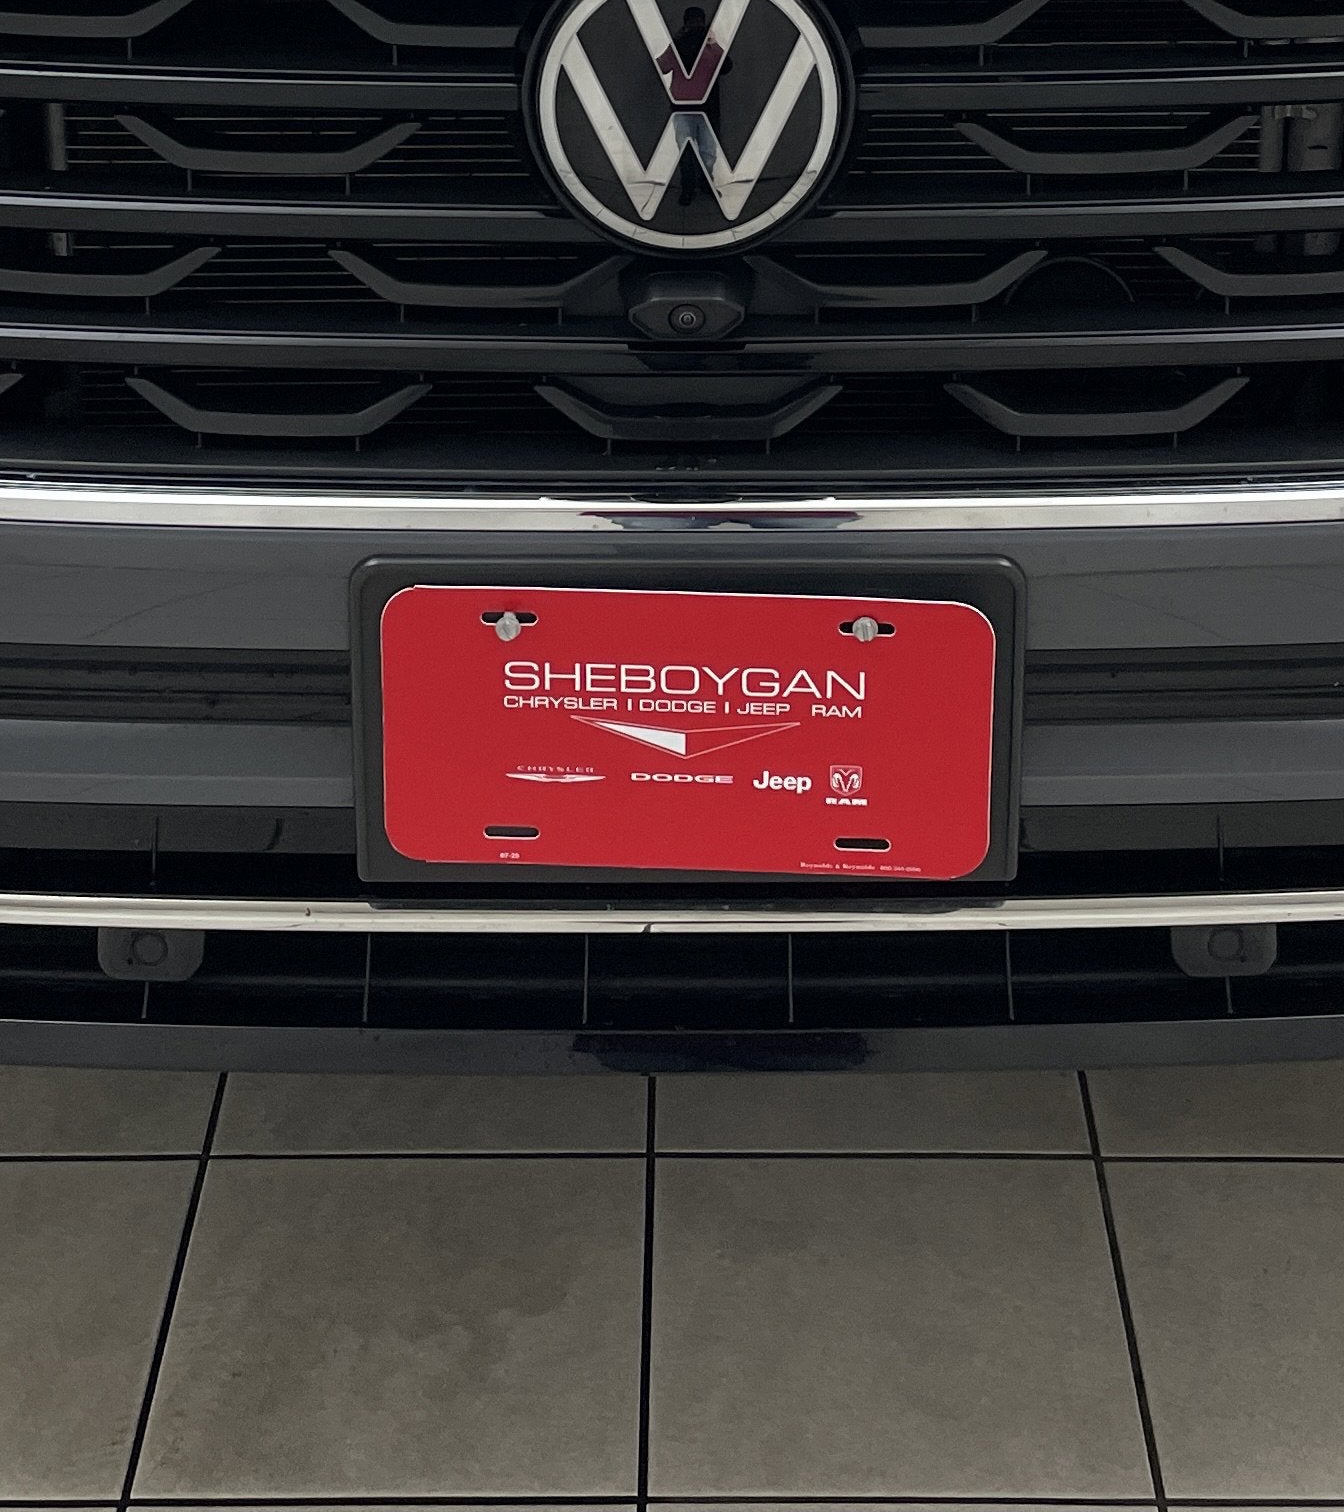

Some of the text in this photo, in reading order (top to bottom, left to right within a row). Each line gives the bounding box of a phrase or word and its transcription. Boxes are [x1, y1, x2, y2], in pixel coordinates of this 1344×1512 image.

[503, 660, 866, 701] SHEBOYGAN
[503, 695, 863, 719] CHRYSLER DODGE JEEP RAM
[631, 772, 734, 785] DODGE
[752, 769, 813, 794] Jeep
[825, 796, 868, 807] RAM
